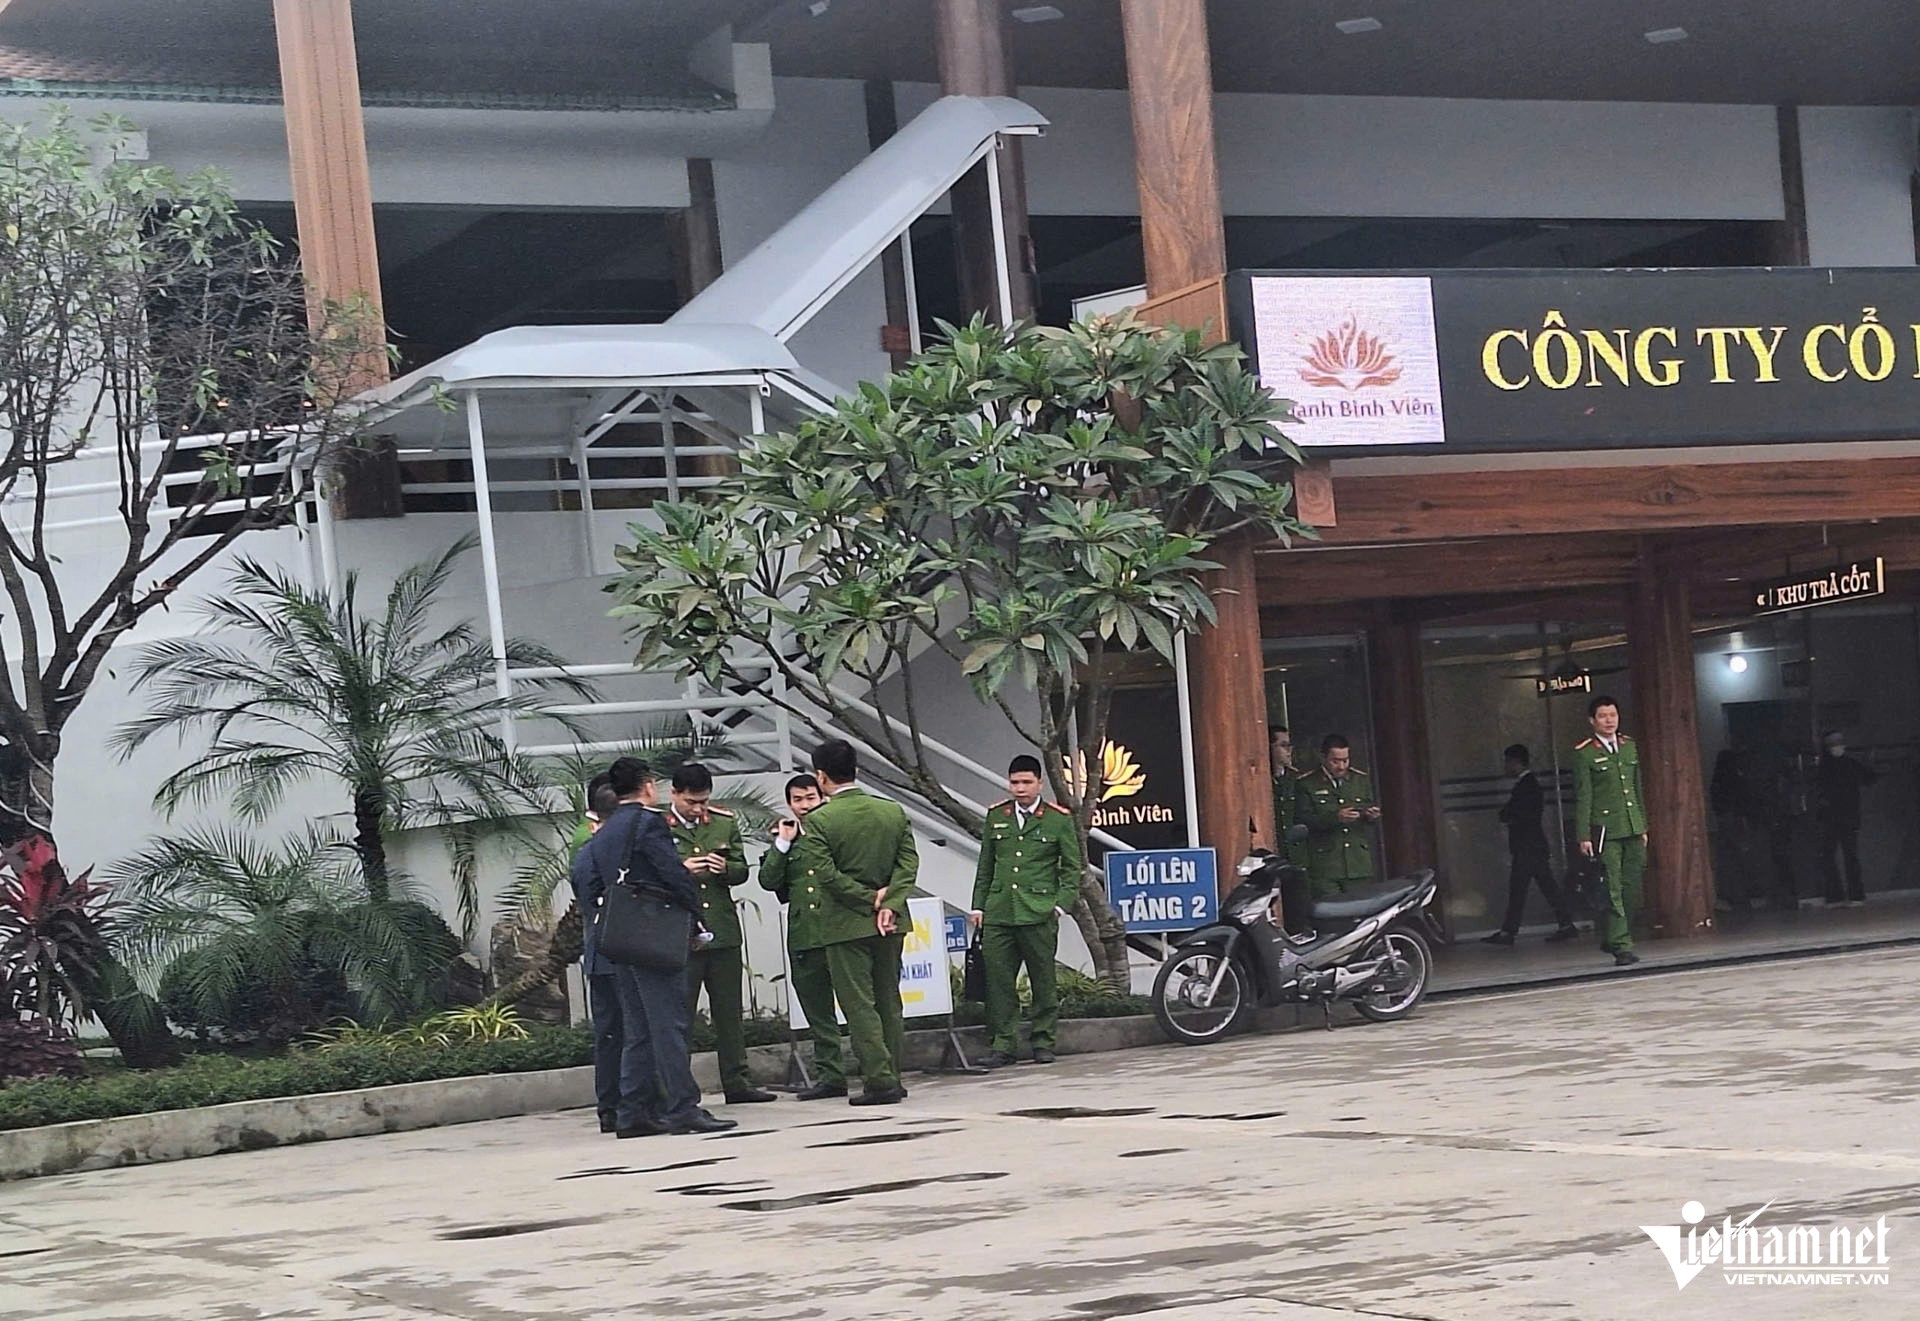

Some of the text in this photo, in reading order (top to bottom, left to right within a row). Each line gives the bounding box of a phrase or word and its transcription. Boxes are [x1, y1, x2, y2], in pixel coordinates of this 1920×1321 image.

[1481, 309, 1685, 391] CÔNG
[1696, 325, 1789, 383] TY
[1803, 306, 1896, 383] CỔ
[1291, 399, 1333, 418] anh
[1391, 397, 1435, 417] Viên
[1777, 583, 1807, 606] KHU
[1841, 563, 1871, 594] CỐT
[1133, 803, 1174, 823] Viên
[1126, 855, 1196, 886] LỐI LÊN
[1118, 891, 1207, 922] TẦNG 2
